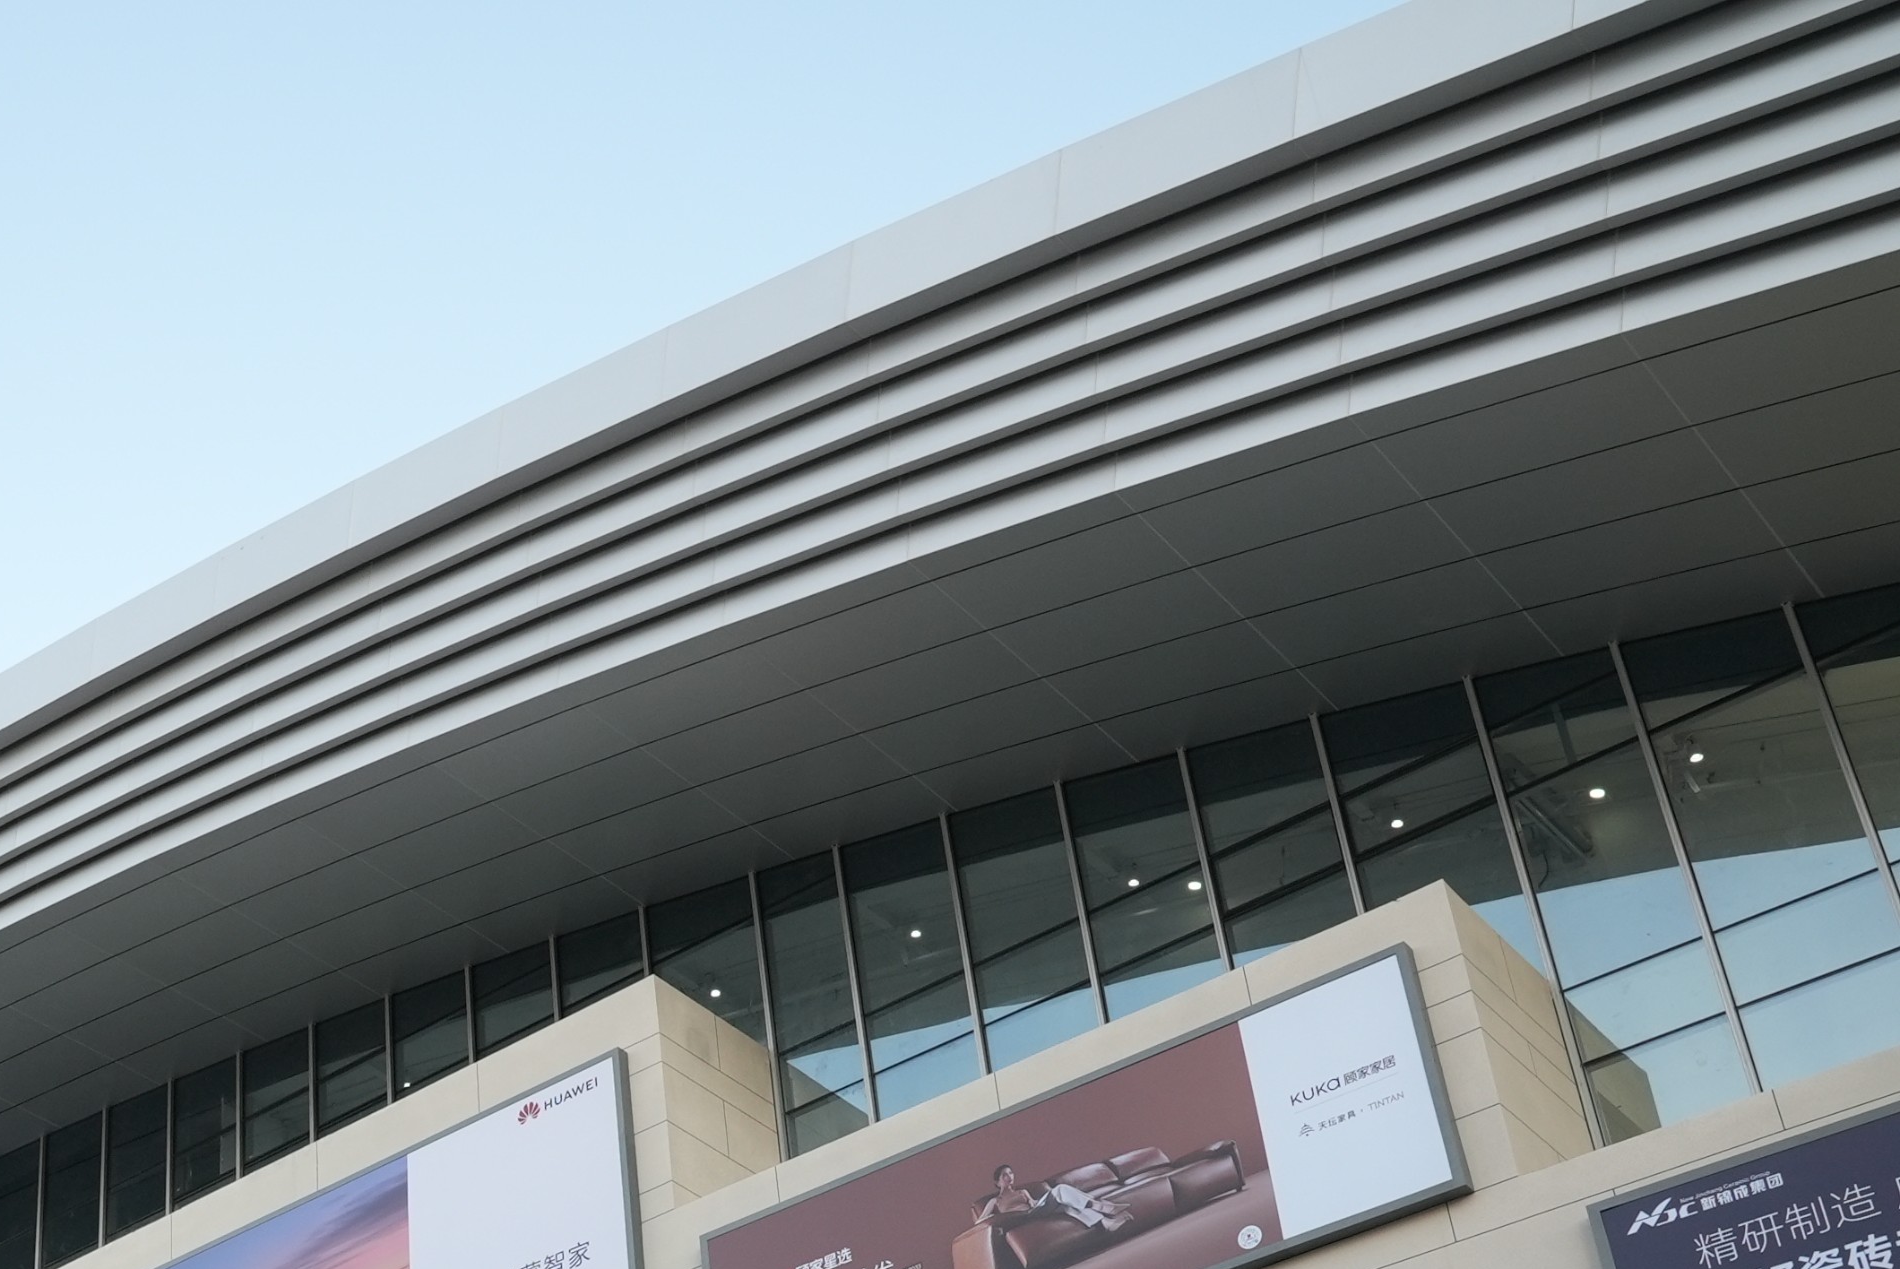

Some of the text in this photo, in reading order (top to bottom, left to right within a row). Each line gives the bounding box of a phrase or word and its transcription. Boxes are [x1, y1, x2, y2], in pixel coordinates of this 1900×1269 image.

[1343, 1054, 1397, 1087] 顾家家居
[543, 1076, 600, 1112] HUAWEI
[1317, 1090, 1405, 1132] 天坛家具 TINTAN
[1693, 1182, 1883, 1269] 精研制造
